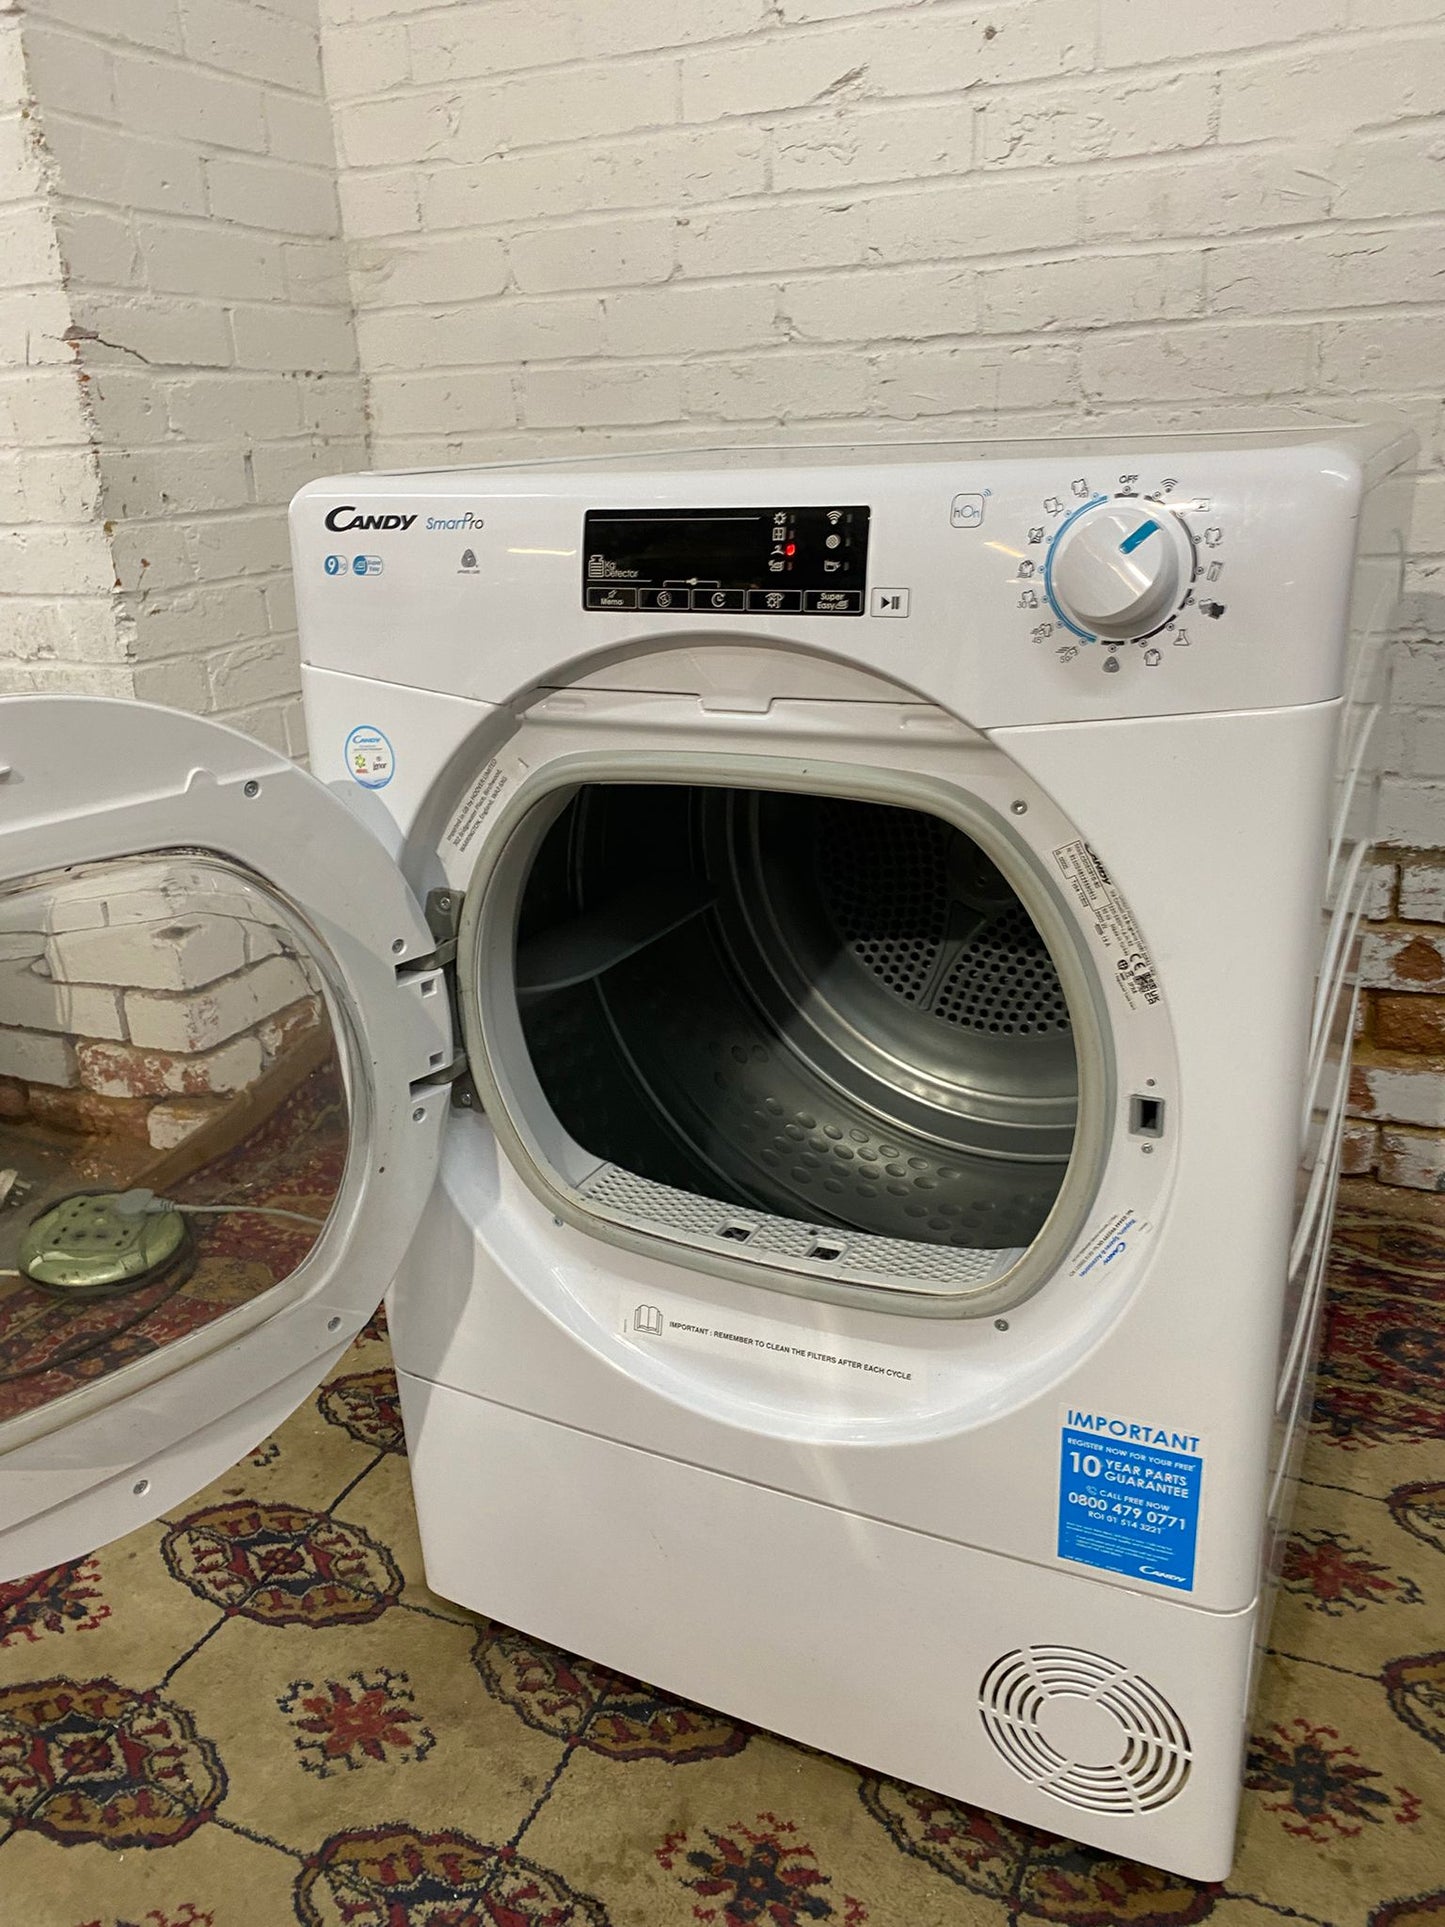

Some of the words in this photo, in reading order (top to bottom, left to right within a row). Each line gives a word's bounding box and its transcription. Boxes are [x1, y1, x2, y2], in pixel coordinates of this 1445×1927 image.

[1119, 474, 1139, 484] OFF
[325, 506, 417, 533] CANDY
[327, 558, 336, 573] 9
[605, 560, 617, 571] Kg
[605, 569, 639, 578] Detector
[600, 598, 624, 606] Memo
[816, 601, 835, 611] Easy
[820, 592, 846, 602] Super
[669, 1321, 708, 1336] IMPORTANT
[714, 1330, 754, 1346] REMEMBER
[755, 1339, 765, 1348] TO
[766, 1342, 790, 1354] CLEAN
[791, 1347, 806, 1357] THE
[807, 1351, 837, 1364] FILTERS
[838, 1358, 862, 1370] AFTER
[864, 1364, 885, 1375] EACH
[886, 1369, 912, 1381] CYCLE
[1067, 1410, 1200, 1453] IMPORTANT
[1067, 1437, 1104, 1452] REGISTER
[1106, 1446, 1127, 1457] NOW
[1129, 1452, 1146, 1461] FOR
[1149, 1456, 1173, 1467] YOUR
[1069, 1451, 1101, 1478] 10
[1105, 1459, 1141, 1476] YEAR
[1145, 1468, 1188, 1487] PARTS
[1104, 1471, 1189, 1499] GUARANTEE
[1068, 1491, 1108, 1512] 0800
[1112, 1503, 1142, 1519] 479
[1147, 1511, 1186, 1531] 0771
[1099, 1489, 1121, 1501] CALL
[1123, 1495, 1143, 1507] FREE
[1145, 1501, 1170, 1512] NOW
[1088, 1510, 1105, 1521] ROI
[1107, 1515, 1117, 1524] 01
[1121, 1518, 1137, 1529] 514
[1139, 1565, 1187, 1583] CANDY
